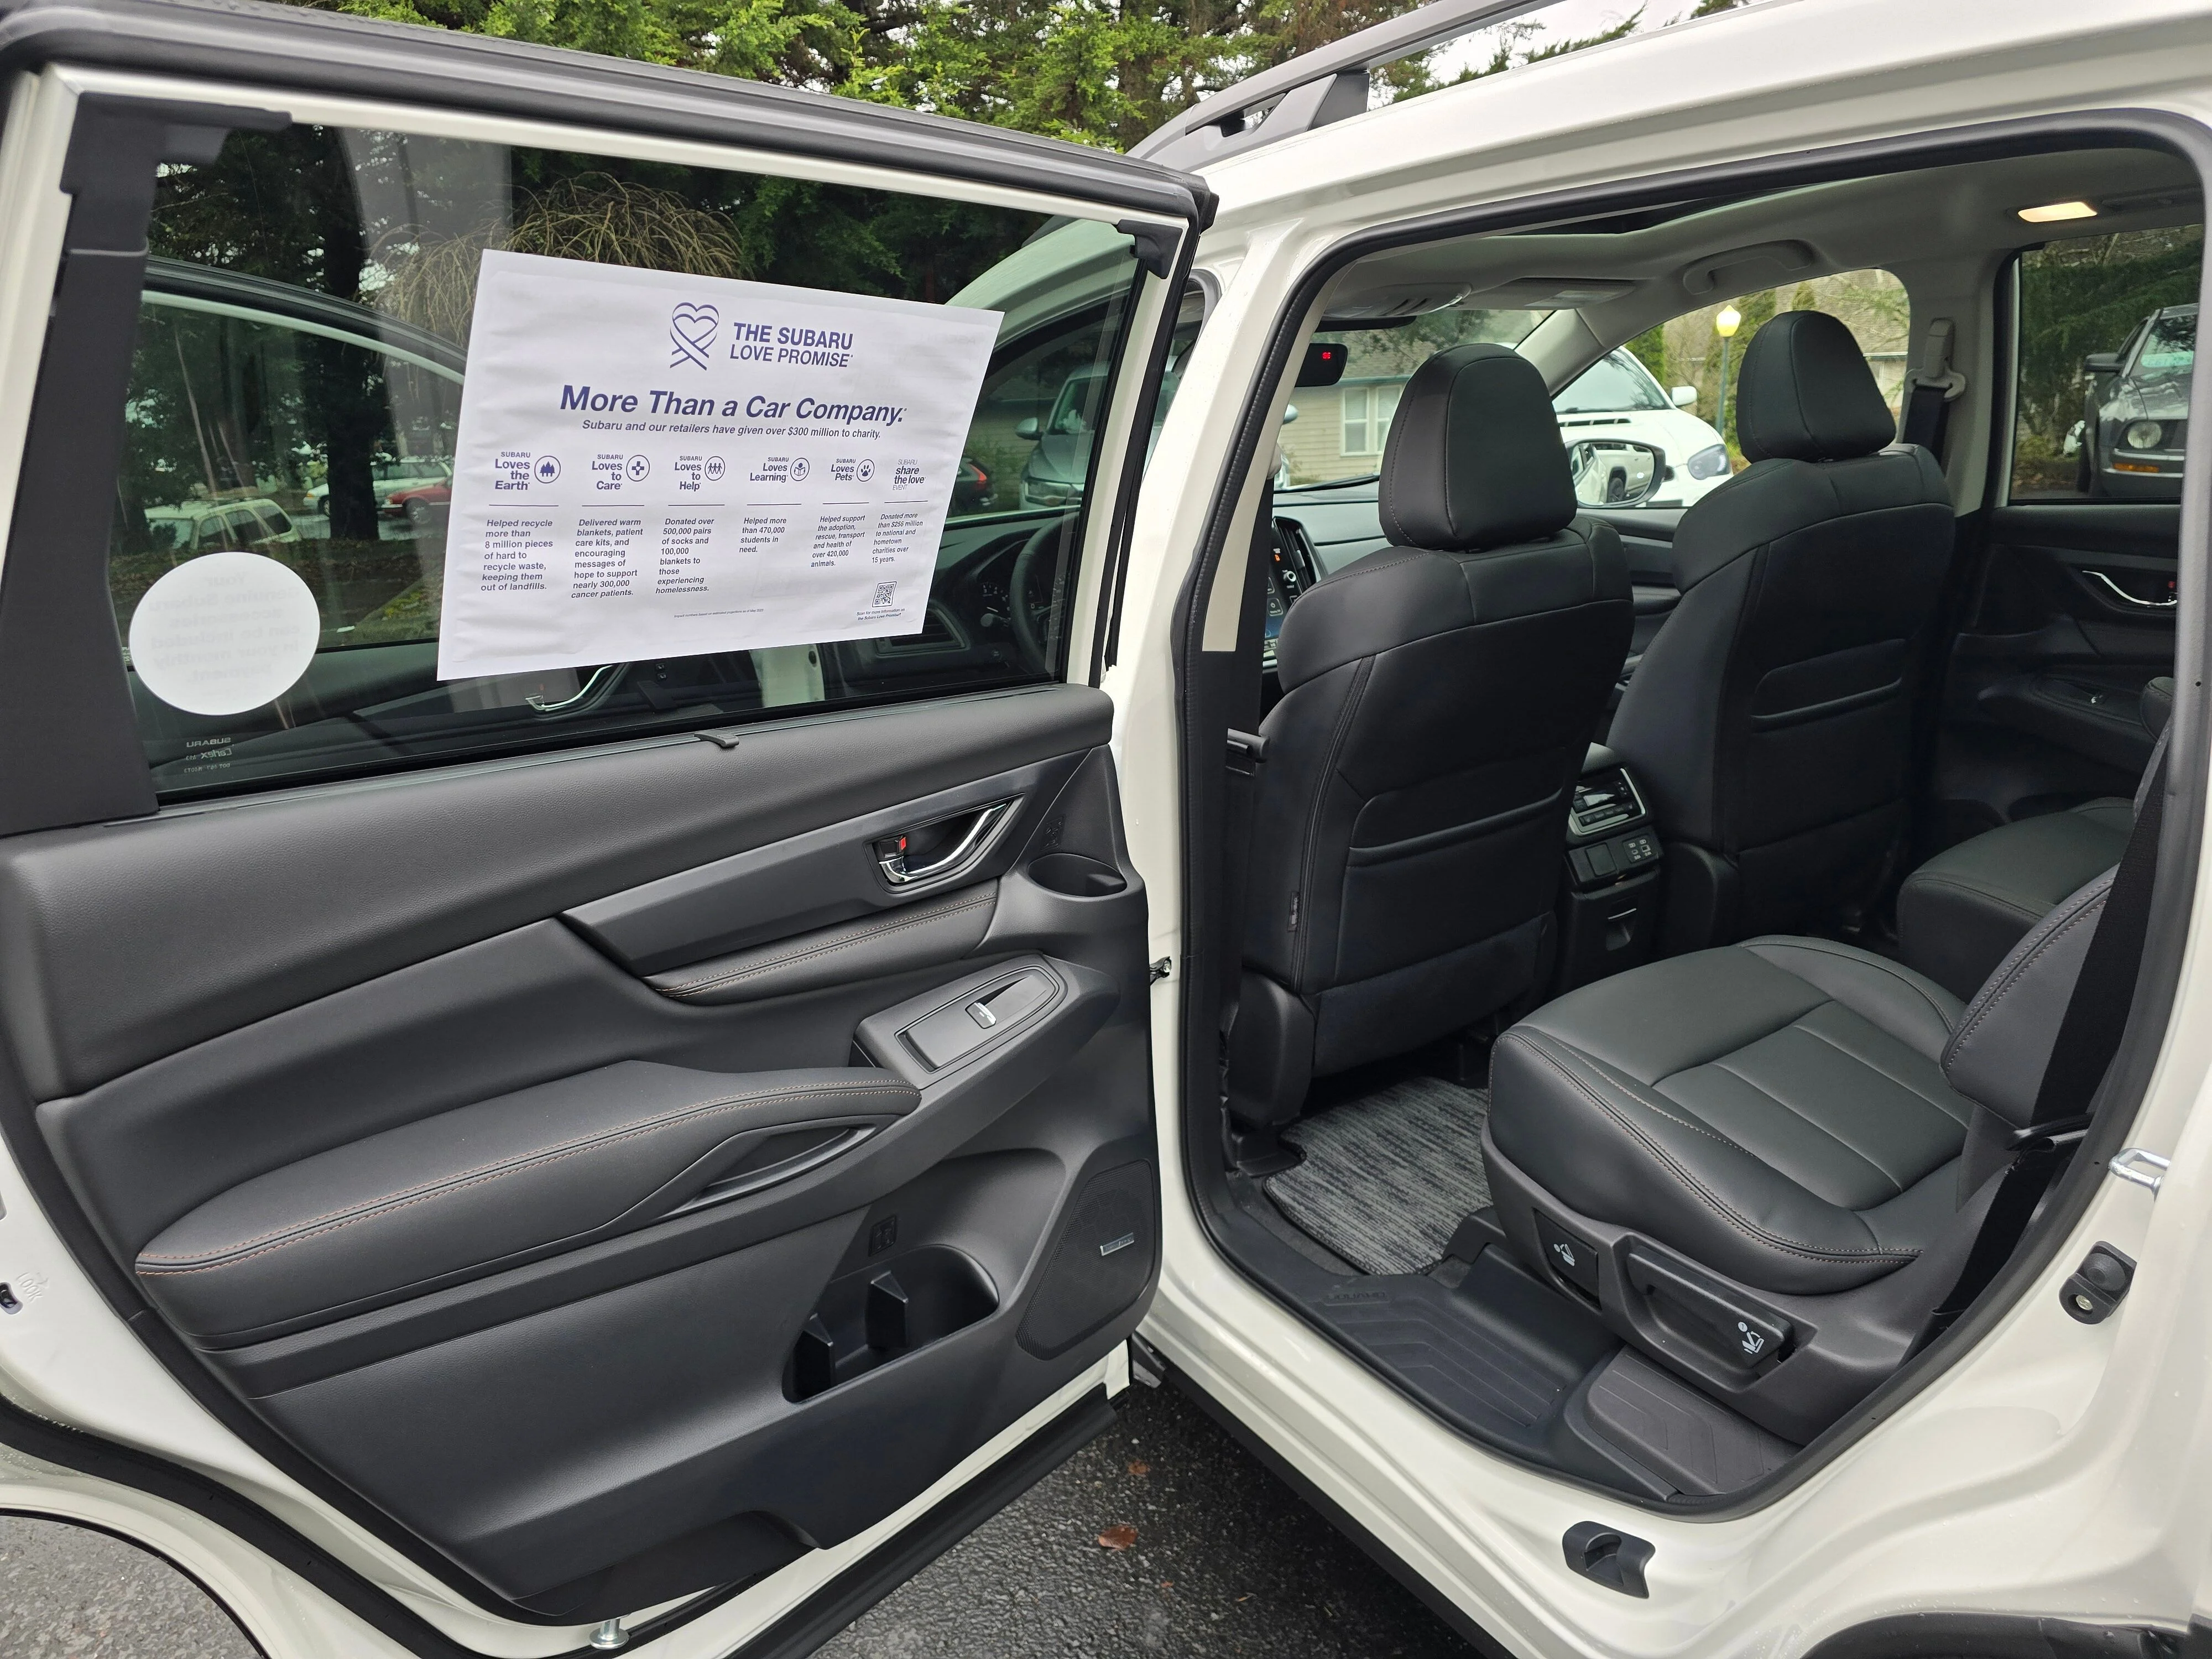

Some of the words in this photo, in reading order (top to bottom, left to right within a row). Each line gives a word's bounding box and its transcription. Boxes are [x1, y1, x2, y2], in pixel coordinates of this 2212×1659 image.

[734, 322, 772, 342] THE
[778, 327, 853, 349] SUBARU
[730, 344, 774, 362] LOVE
[560, 385, 638, 413] More
[650, 390, 714, 415] Than
[722, 400, 738, 416] a
[747, 396, 791, 418] Car
[582, 420, 622, 430] Subaru
[625, 422, 646, 431] and
[669, 424, 709, 433] retailers
[713, 425, 735, 434] have
[737, 426, 763, 436] given
[788, 427, 808, 436] $300
[811, 427, 839, 436] million
[853, 429, 880, 440] charity.
[495, 459, 530, 469] Loves
[592, 461, 622, 470] Loves
[675, 462, 701, 471] Loves
[763, 463, 787, 471] Loves
[896, 466, 919, 474] share
[510, 470, 529, 480] the
[611, 472, 622, 481] to
[895, 475, 907, 484] the
[487, 520, 519, 528] Helped
[521, 520, 552, 528] recycle
[615, 529, 643, 537] patient
[525, 540, 552, 549] pieces
[596, 539, 612, 547] kits,
[575, 549, 625, 558] encouraging
[880, 555, 895, 564] years.
[484, 563, 515, 572] recycle
[482, 573, 518, 582] keeping
[607, 570, 637, 578] support
[573, 581, 598, 589] nearly
[658, 577, 704, 586] experiencing
[600, 589, 633, 598] patients.
